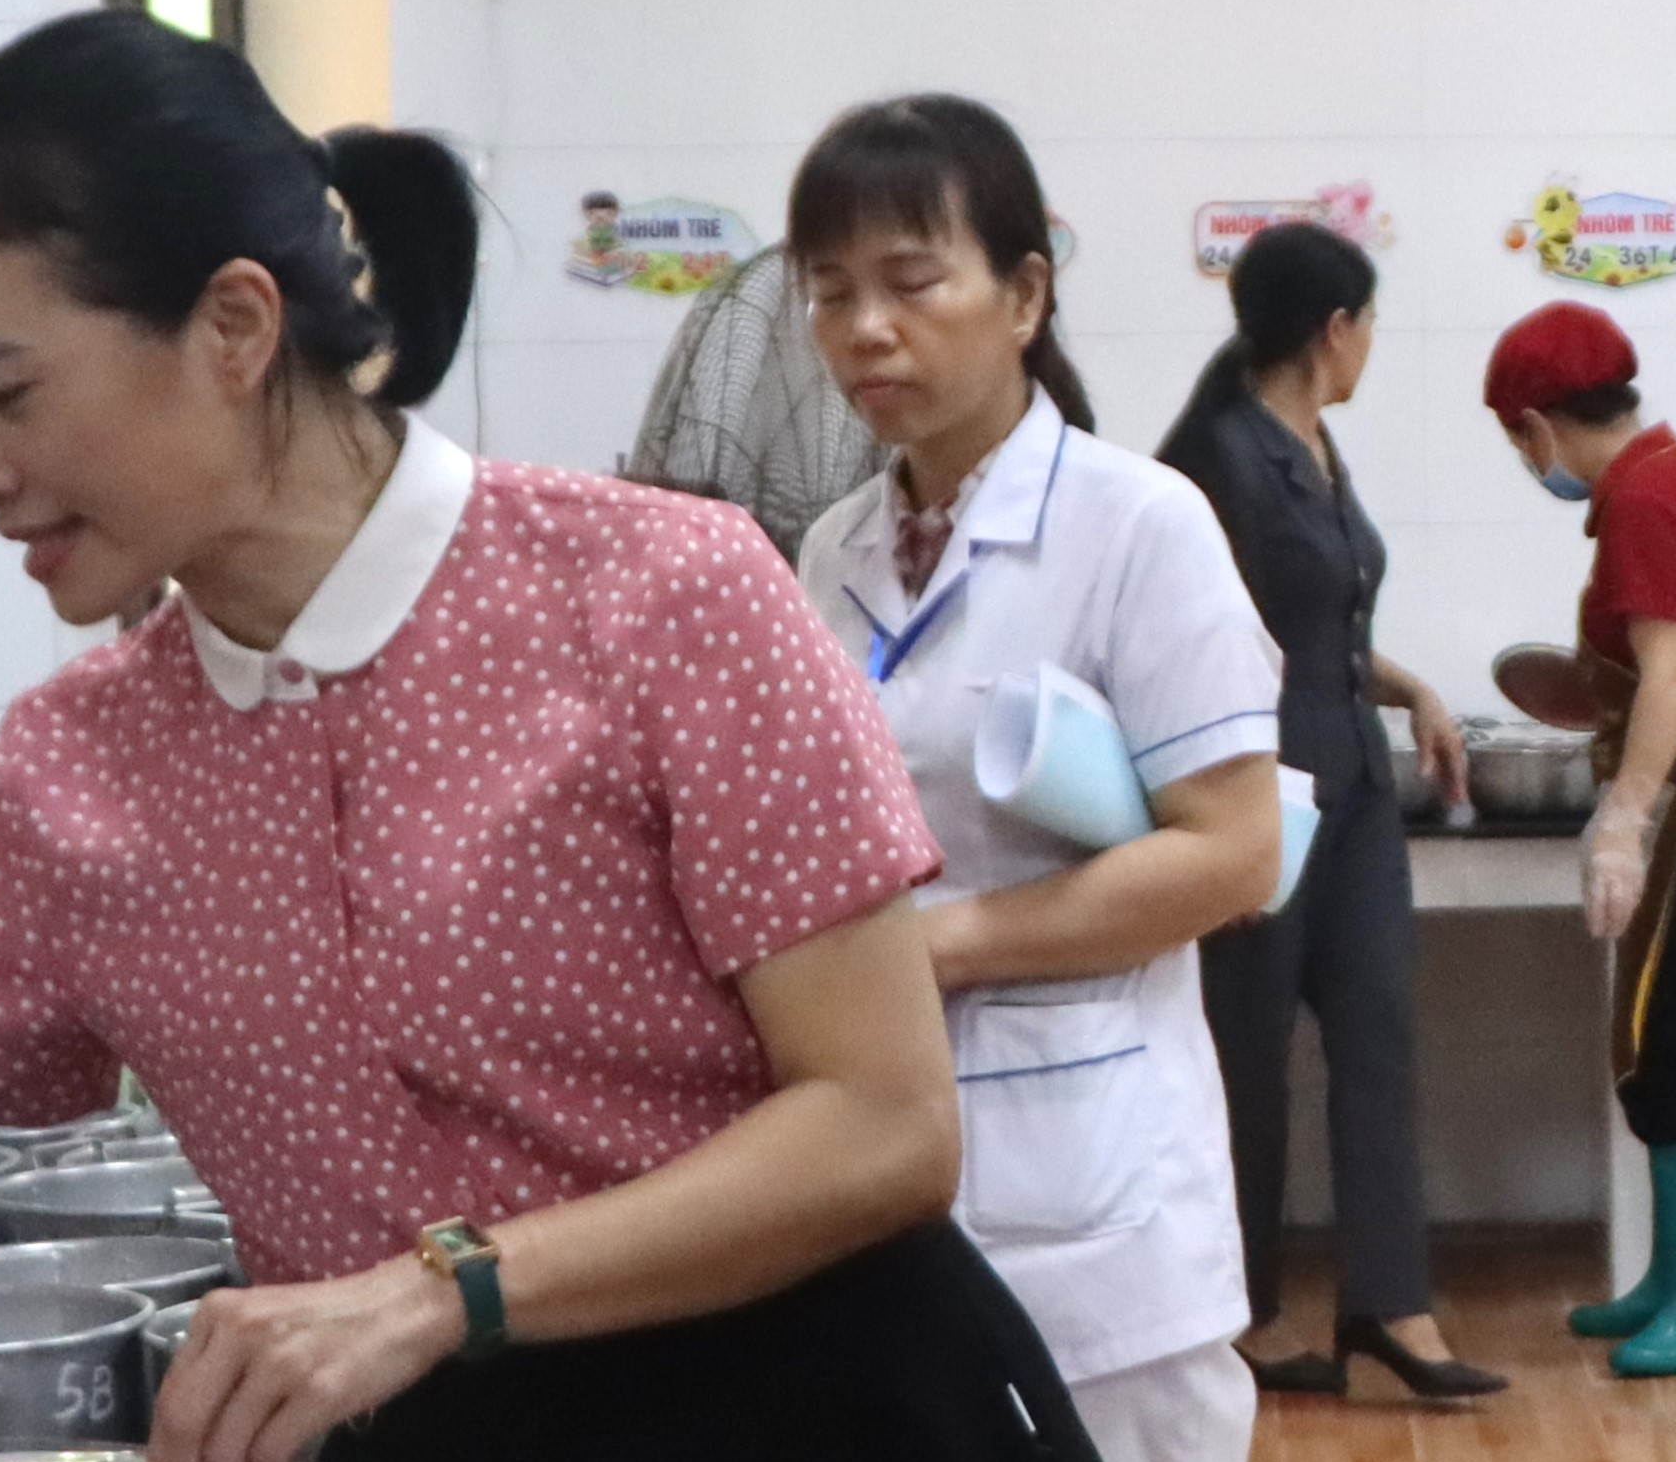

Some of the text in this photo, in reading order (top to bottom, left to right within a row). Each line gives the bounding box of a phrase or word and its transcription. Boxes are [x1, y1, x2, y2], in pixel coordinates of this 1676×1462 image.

[619, 214, 681, 239] NHÓM
[1576, 211, 1636, 234] NHÓM
[1203, 246, 1230, 266] 24
